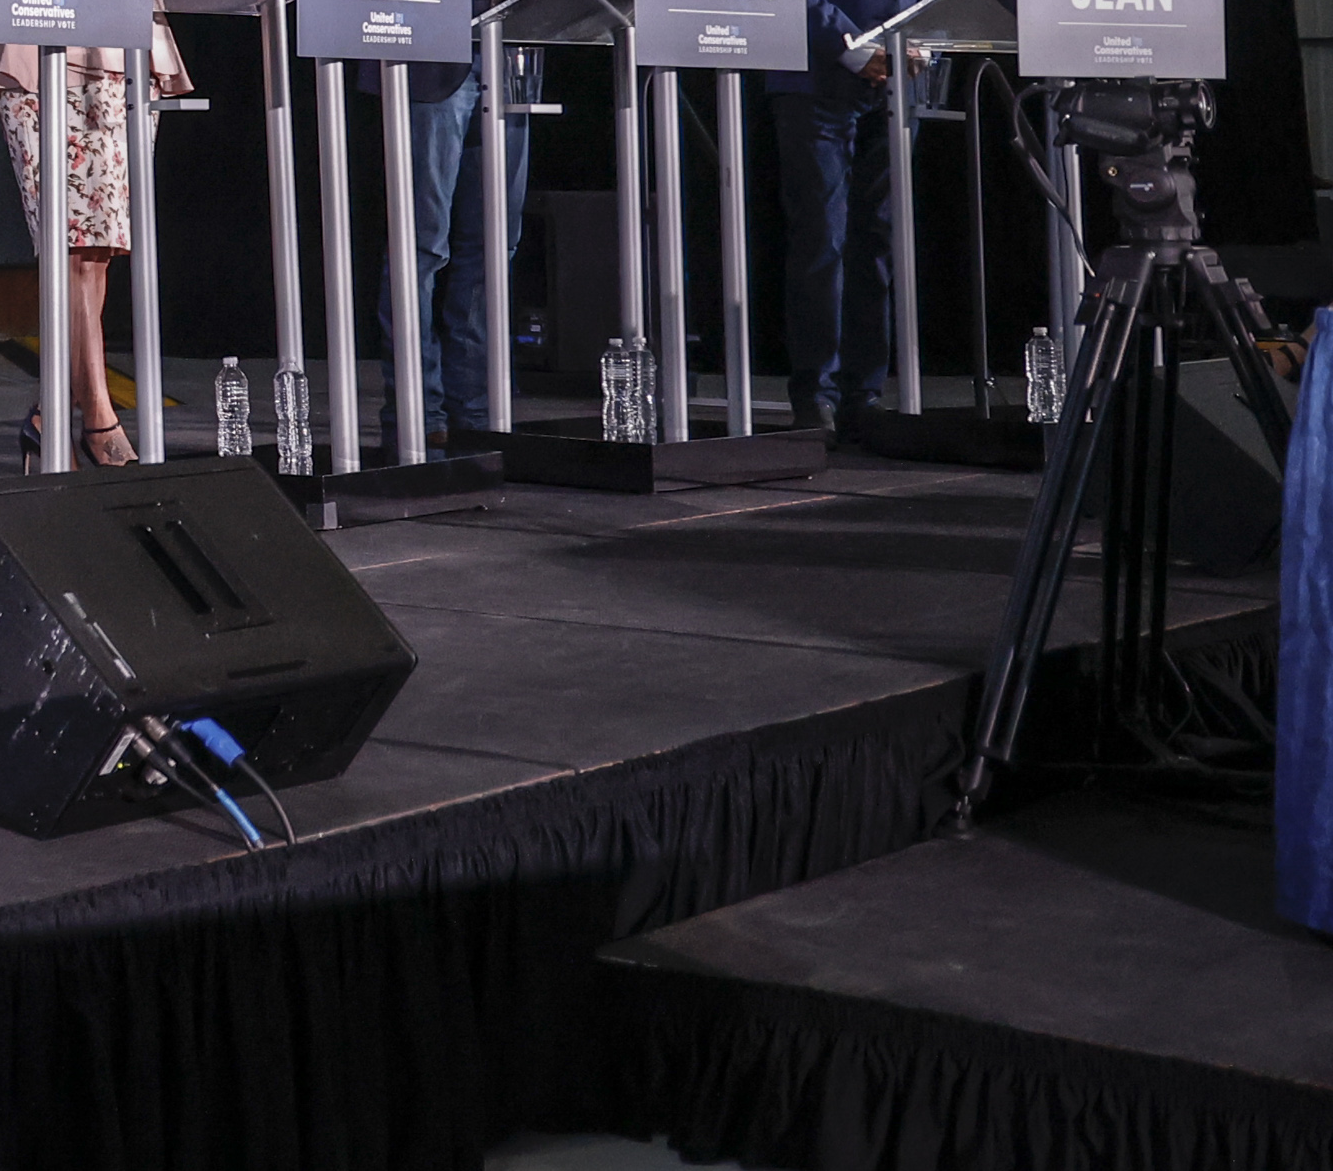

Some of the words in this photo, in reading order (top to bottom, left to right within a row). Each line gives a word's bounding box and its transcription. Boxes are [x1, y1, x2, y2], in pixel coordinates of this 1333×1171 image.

[11, 3, 75, 19] Conservatives
[370, 11, 394, 24] United
[12, 18, 56, 29] LEADERSHIP
[57, 20, 76, 29] VOTE
[362, 22, 412, 35] Conservatives
[706, 25, 729, 36] United
[362, 35, 397, 44] LEADERSHIP
[397, 36, 412, 45] VOTE
[698, 34, 747, 46] Conservatives
[1103, 36, 1131, 46] United
[698, 46, 732, 54] LEADERSHIP
[1094, 45, 1153, 56] Conservatives
